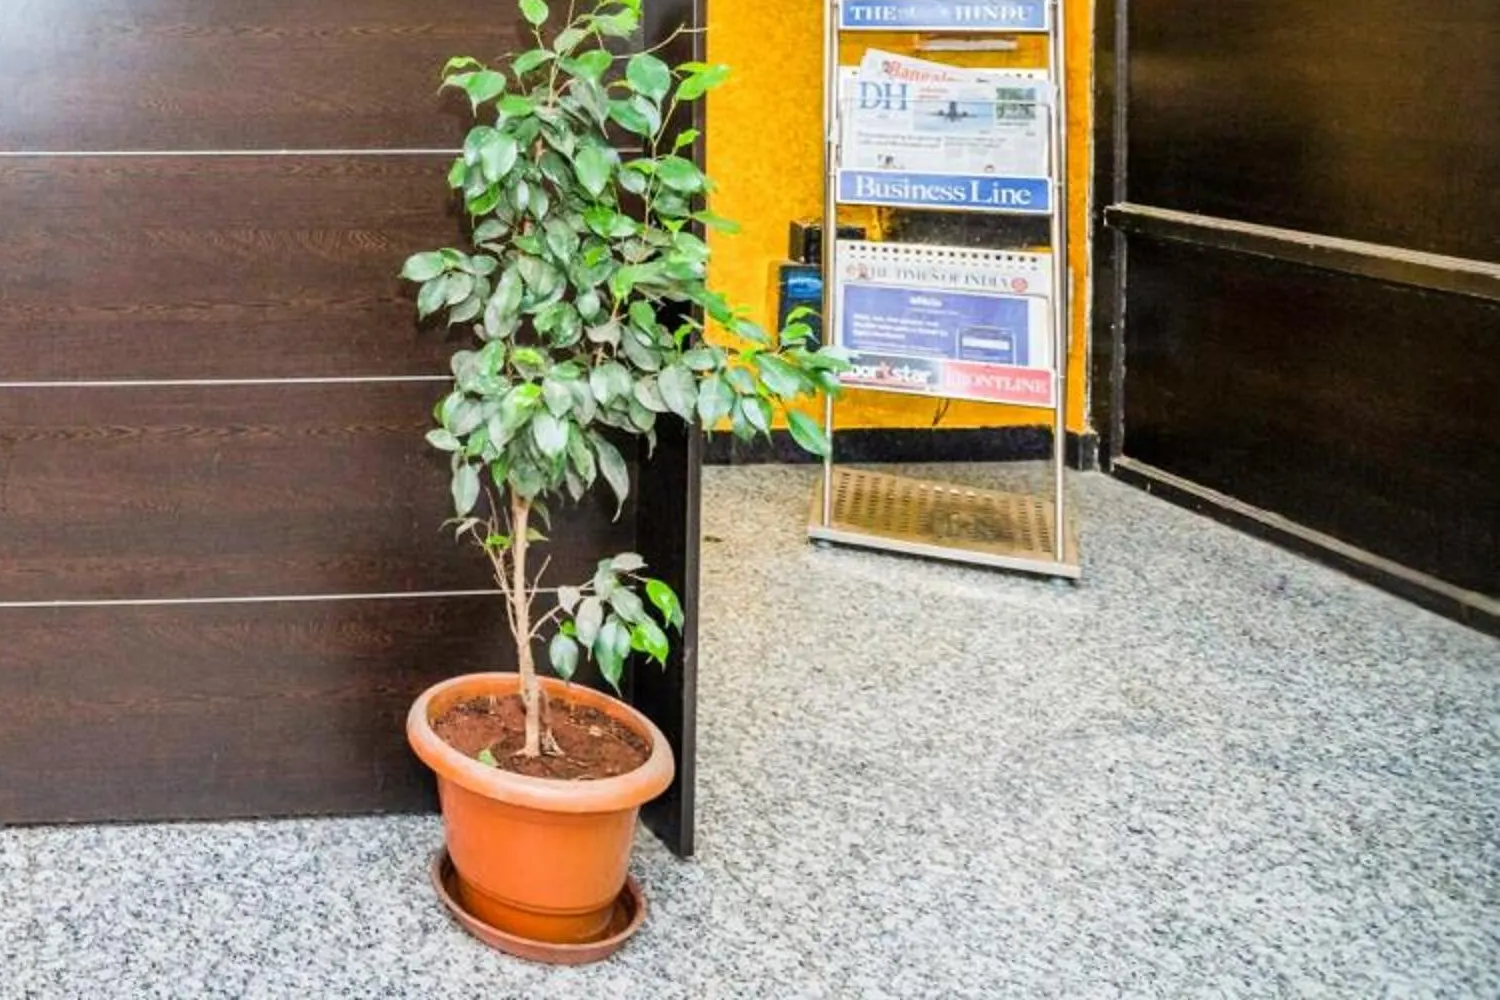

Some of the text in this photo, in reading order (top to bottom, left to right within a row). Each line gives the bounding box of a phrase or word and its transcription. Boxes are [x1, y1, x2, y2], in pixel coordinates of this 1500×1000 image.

[850, 4, 1034, 21] THE HINDU
[859, 81, 909, 111] DH
[855, 174, 1032, 206] Business Line
